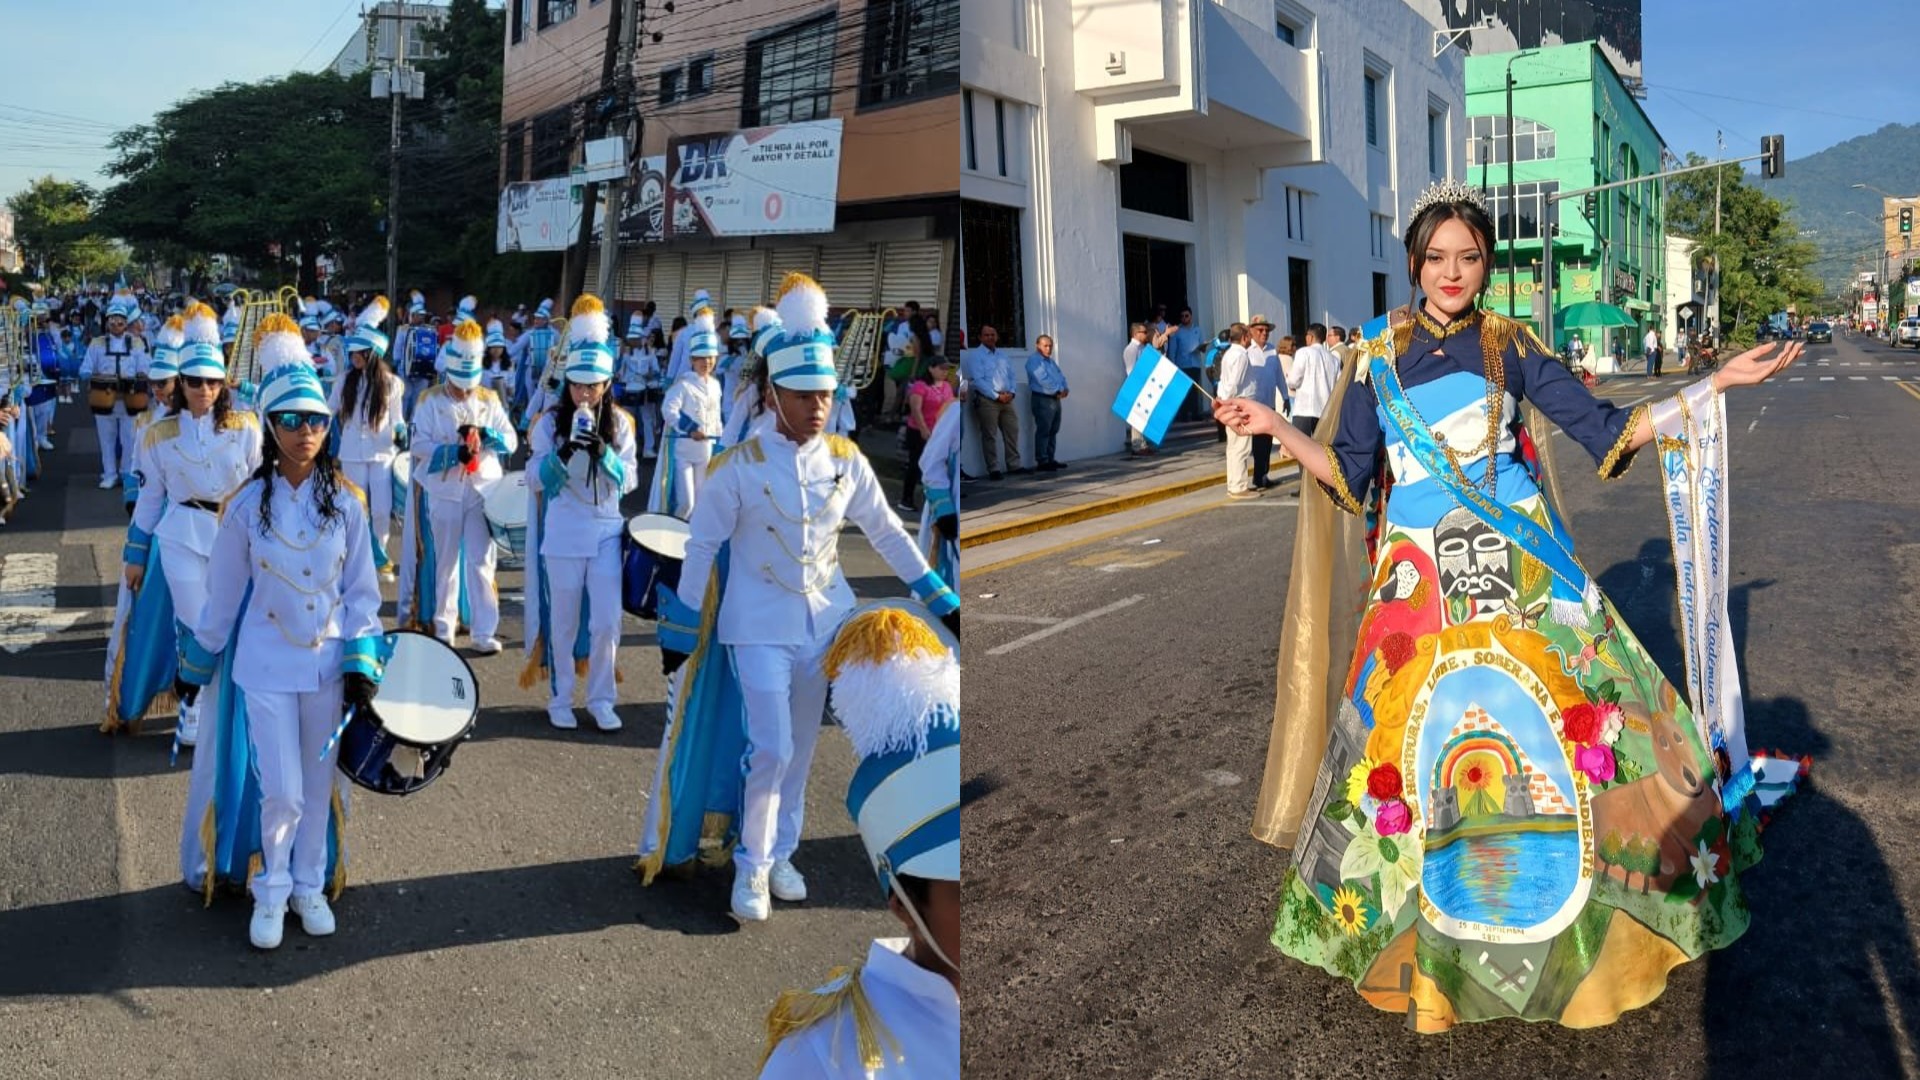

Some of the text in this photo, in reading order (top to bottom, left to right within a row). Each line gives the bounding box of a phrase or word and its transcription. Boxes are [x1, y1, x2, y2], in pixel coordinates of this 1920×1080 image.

[680, 134, 734, 183] DK
[751, 150, 835, 162] MAYOR Y DETALLE
[759, 140, 829, 153] TIENDA AL POR
[1700, 467, 1720, 579] Excelencia
[1474, 651, 1549, 707] SOBERANA
